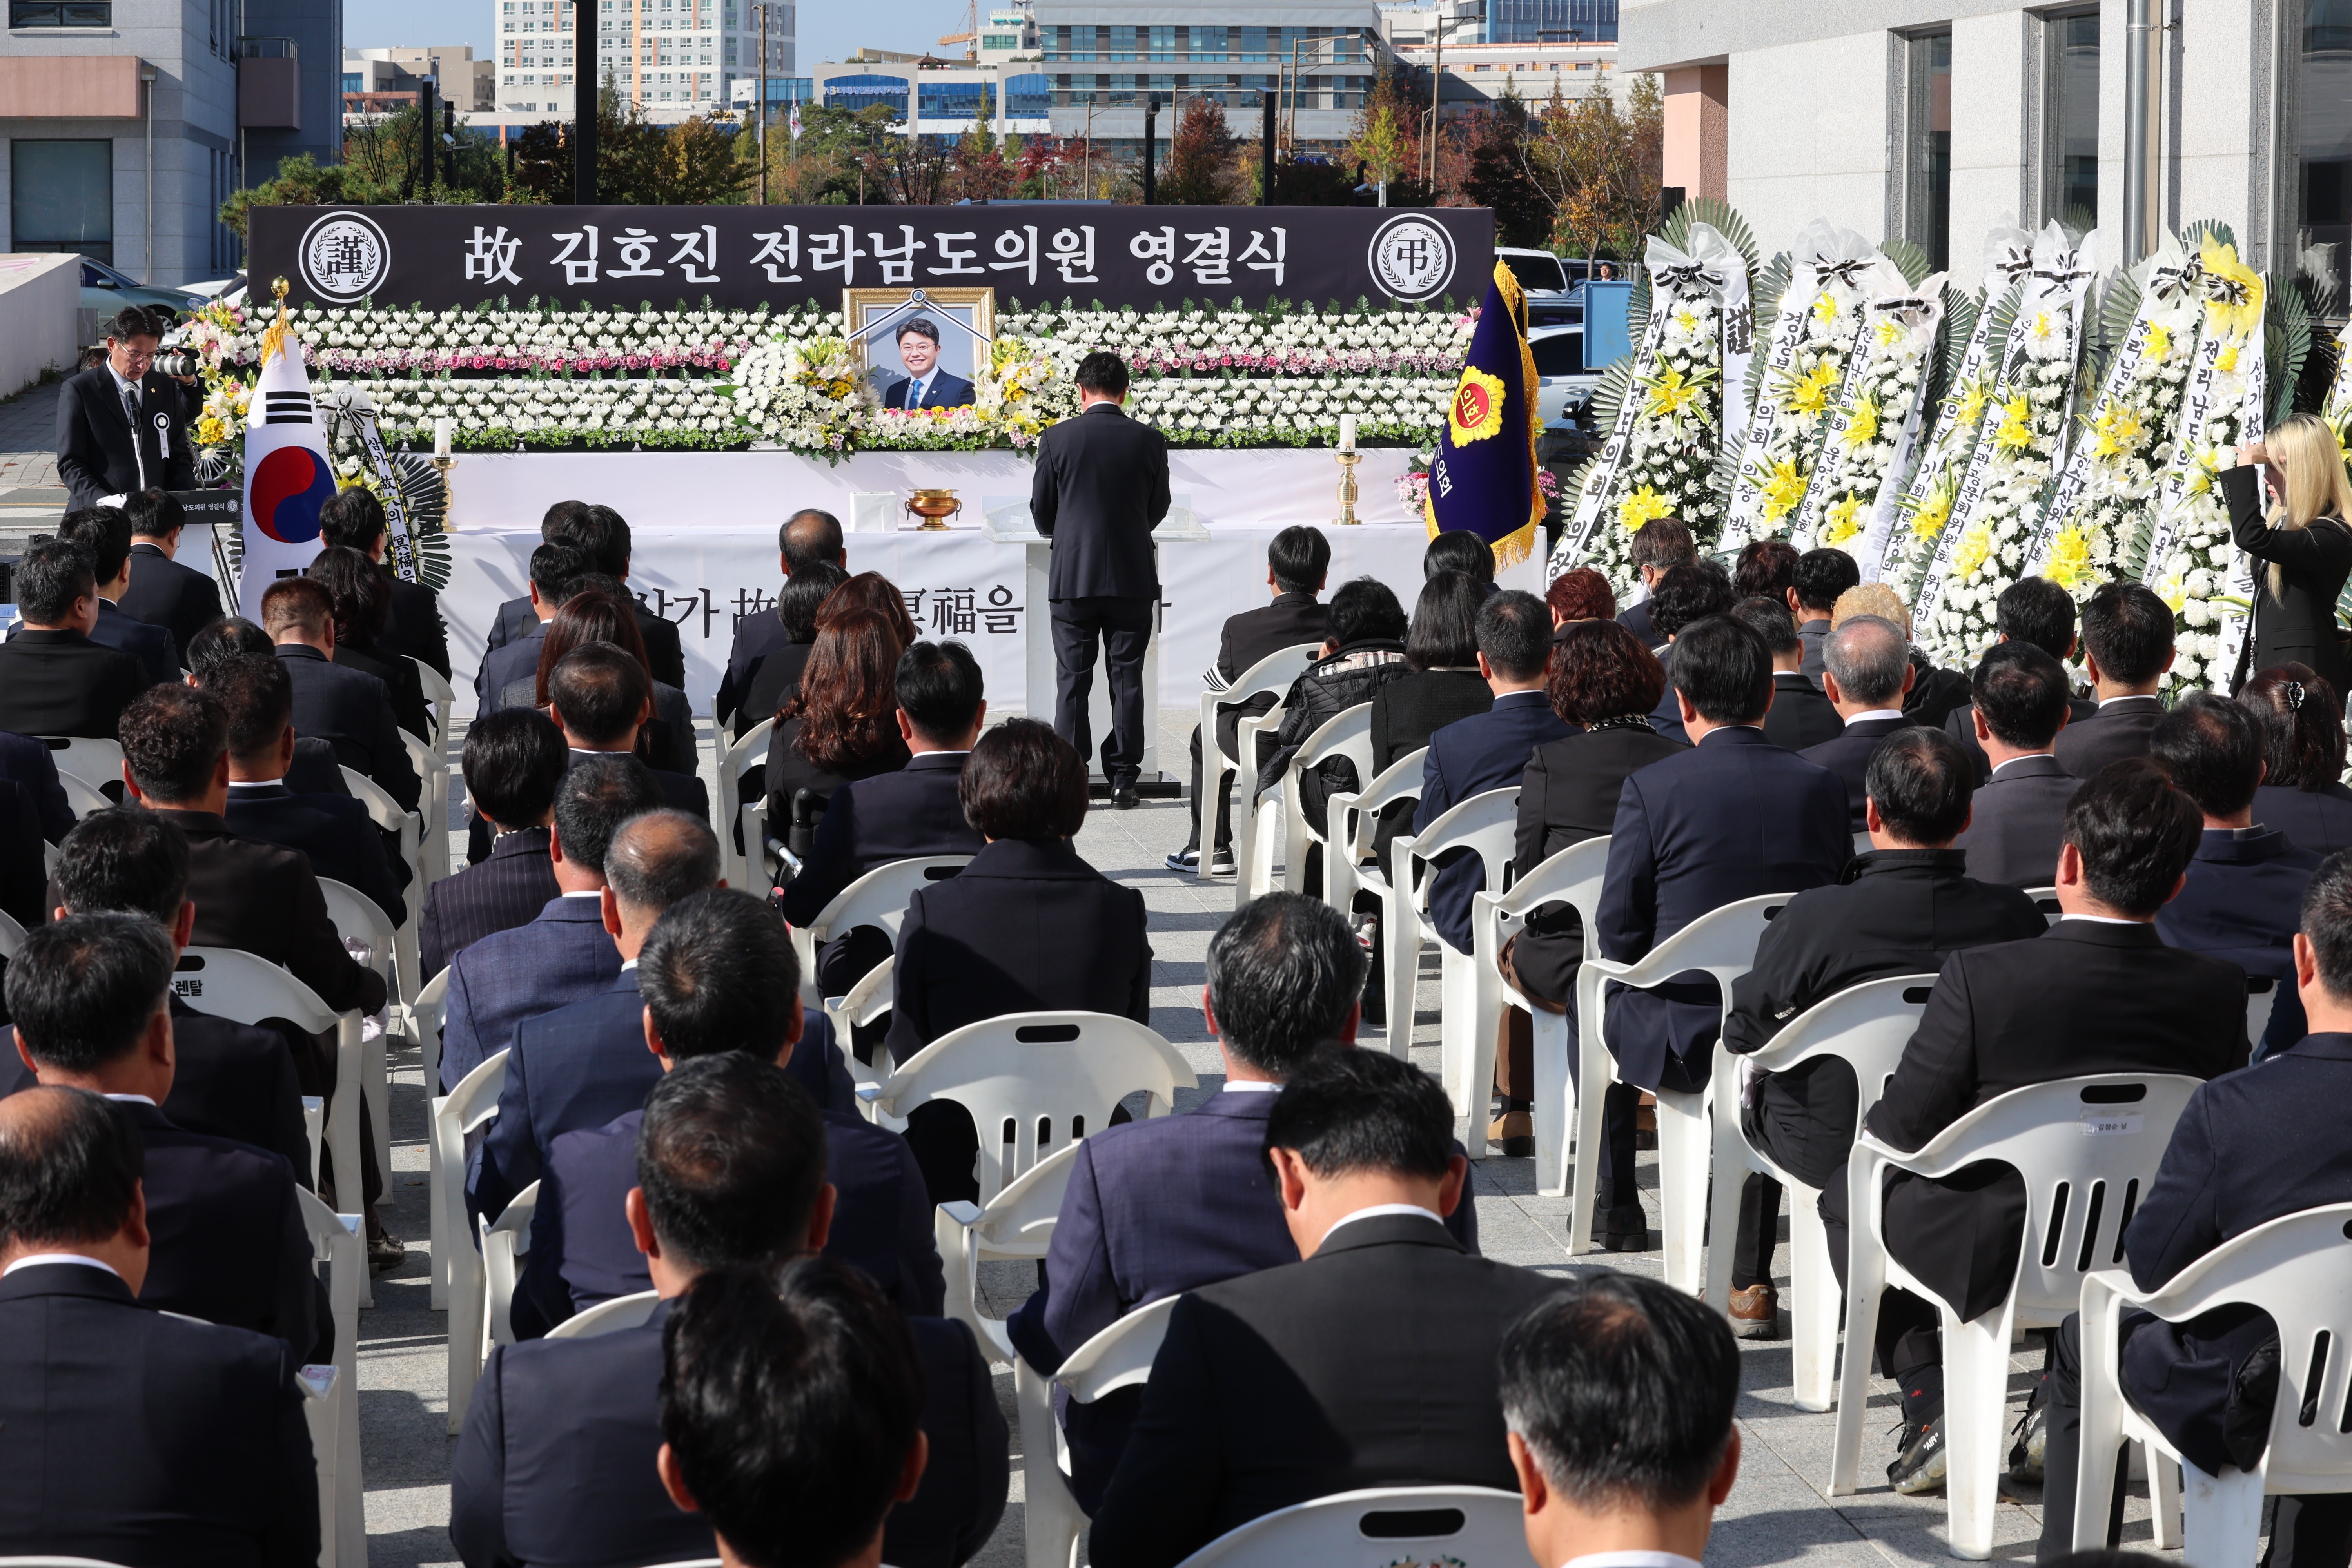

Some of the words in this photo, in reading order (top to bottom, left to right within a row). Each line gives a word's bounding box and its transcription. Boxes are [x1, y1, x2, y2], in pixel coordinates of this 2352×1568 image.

[326, 235, 365, 275] 謹
[464, 226, 523, 285] 故
[550, 225, 720, 285] 김호진
[750, 225, 1099, 286] 전라남도의원
[1130, 226, 1286, 286] 영결식
[1397, 238, 1429, 276] 弔
[1459, 388, 1485, 426] 의회
[2245, 412, 2262, 445] 故
[367, 437, 388, 466] 삼가
[1435, 438, 1453, 498] 도의회
[208, 503, 225, 511] 영결식
[730, 588, 777, 635] 故
[171, 979, 203, 996] 렌탈
[1923, 1432, 1938, 1451] "AIR"
